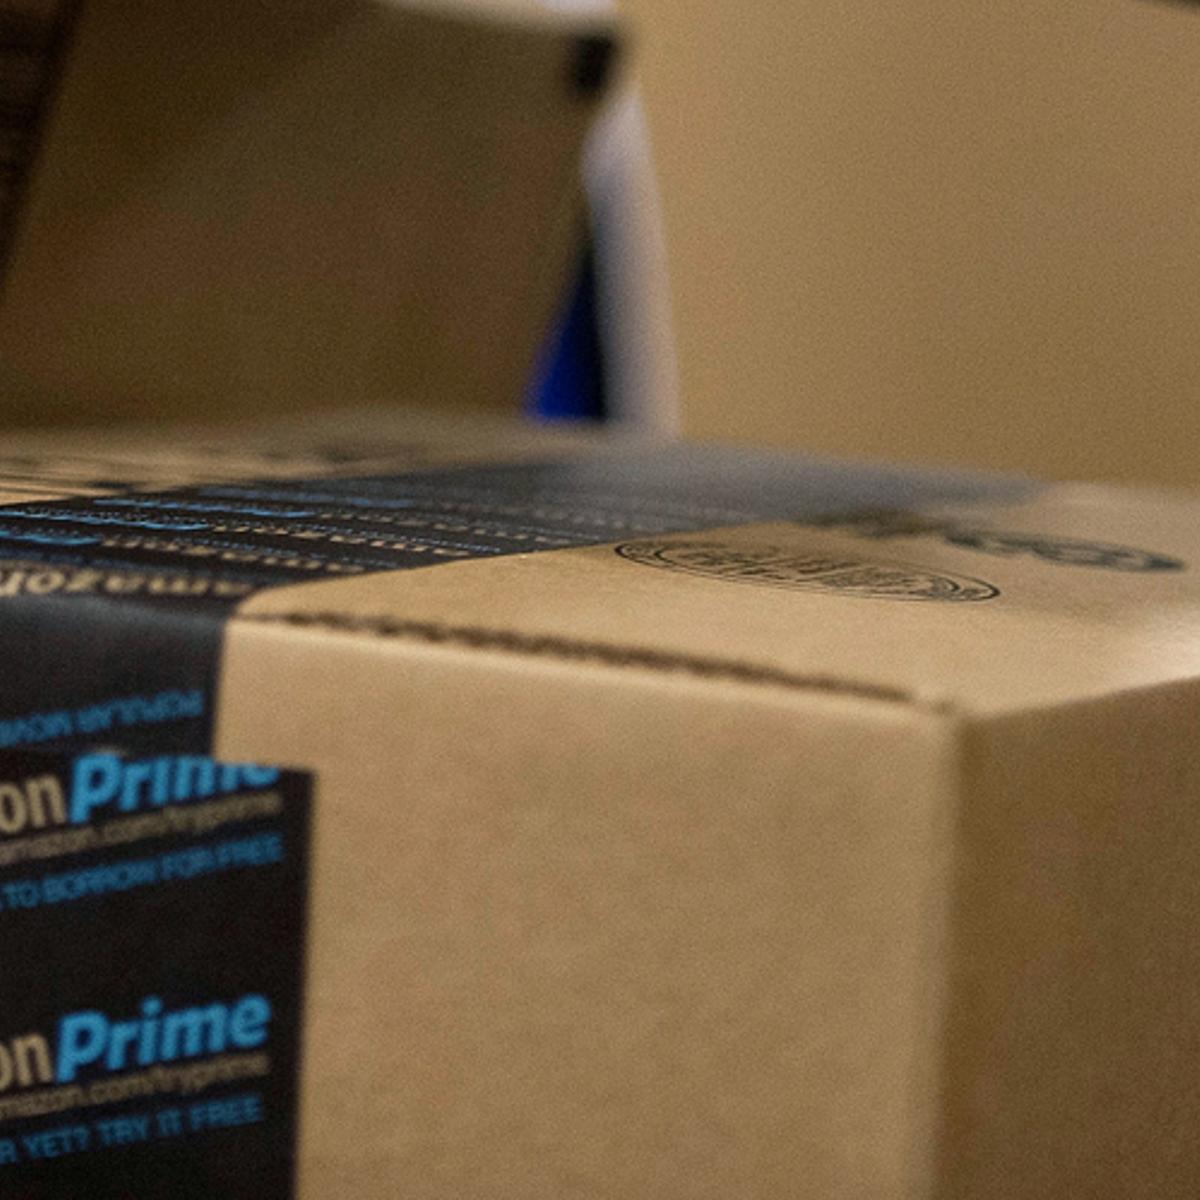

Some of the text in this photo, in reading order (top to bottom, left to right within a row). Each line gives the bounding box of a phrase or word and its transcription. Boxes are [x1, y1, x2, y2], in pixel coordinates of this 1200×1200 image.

[4, 879, 41, 909] TO
[43, 860, 156, 902] BORROW
[161, 847, 214, 880] FOR
[217, 832, 283, 867] FREE
[25, 1125, 92, 1159] YET?
[100, 1114, 149, 1144] TRY
[156, 1107, 182, 1134] IT
[189, 1096, 262, 1129] FREE
